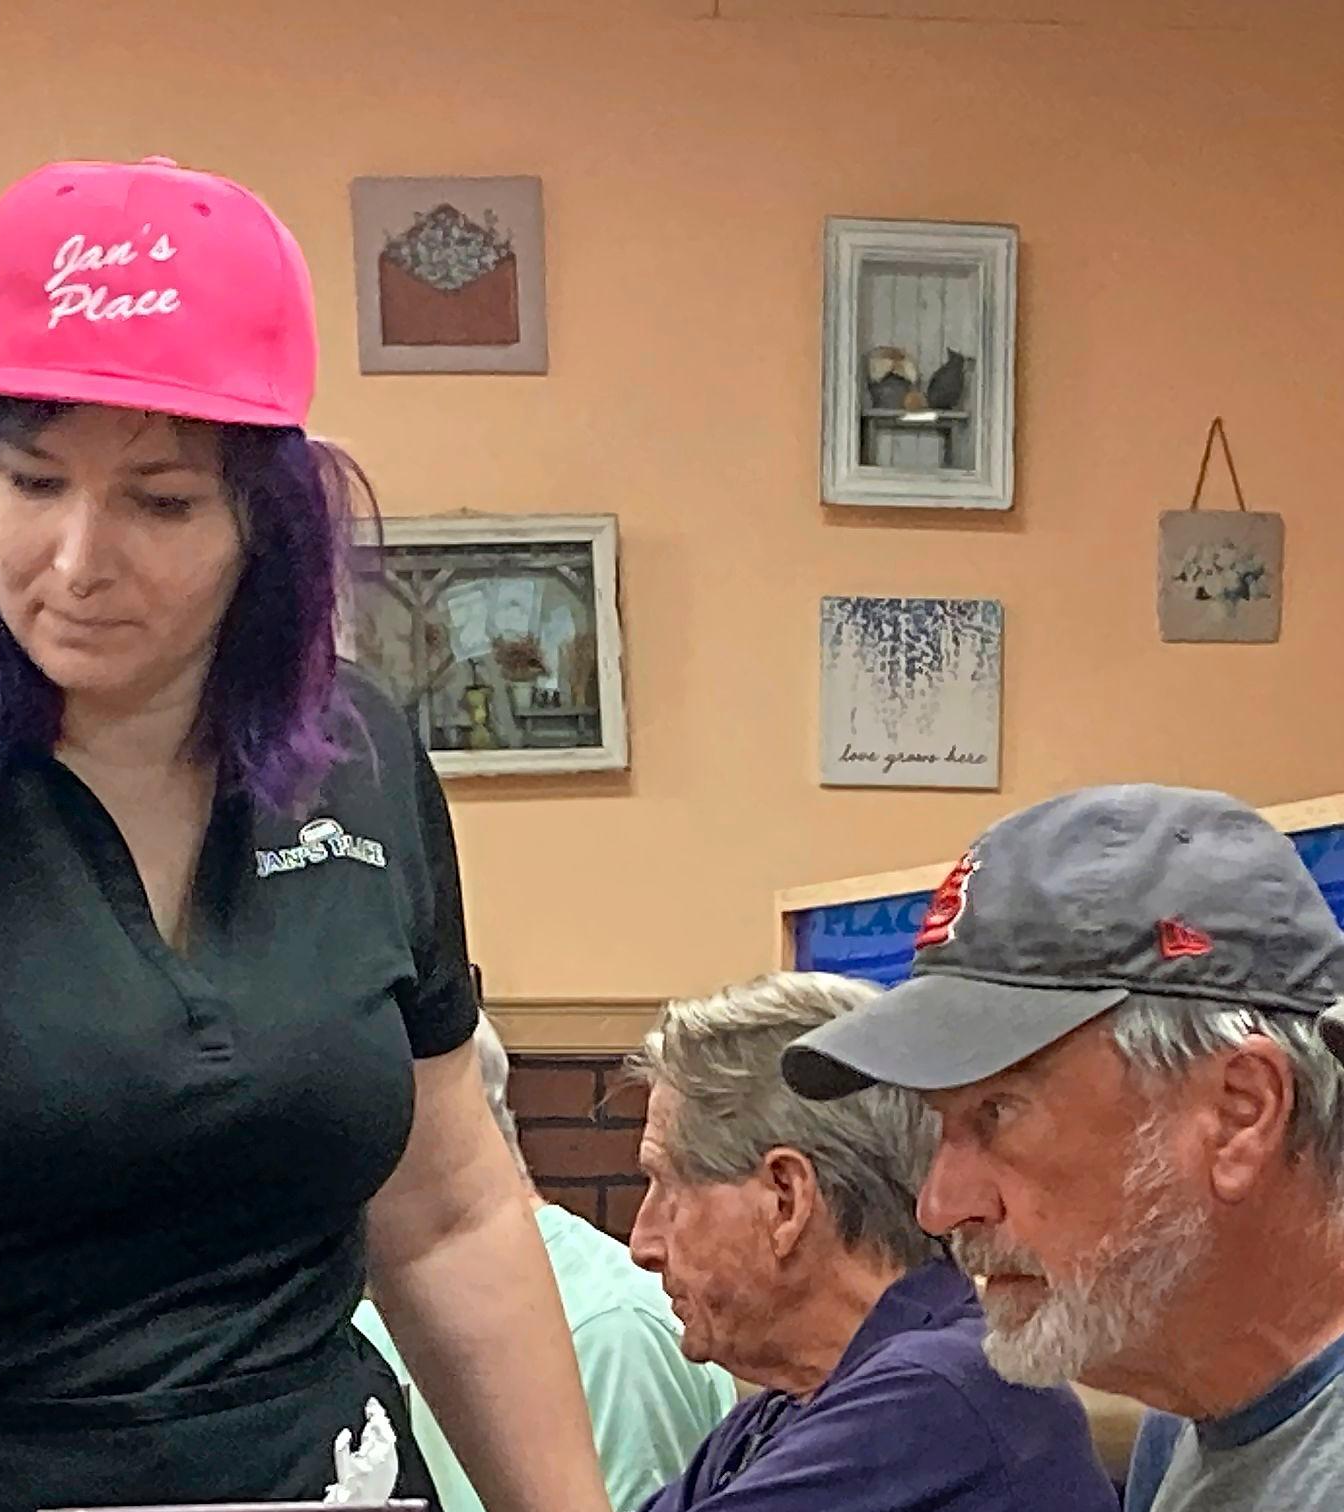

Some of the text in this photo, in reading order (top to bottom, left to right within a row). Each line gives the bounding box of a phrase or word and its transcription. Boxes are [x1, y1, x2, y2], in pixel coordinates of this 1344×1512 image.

[44, 222, 178, 292] Jan's
[48, 283, 181, 329] Place
[838, 743, 988, 774] love grows here
